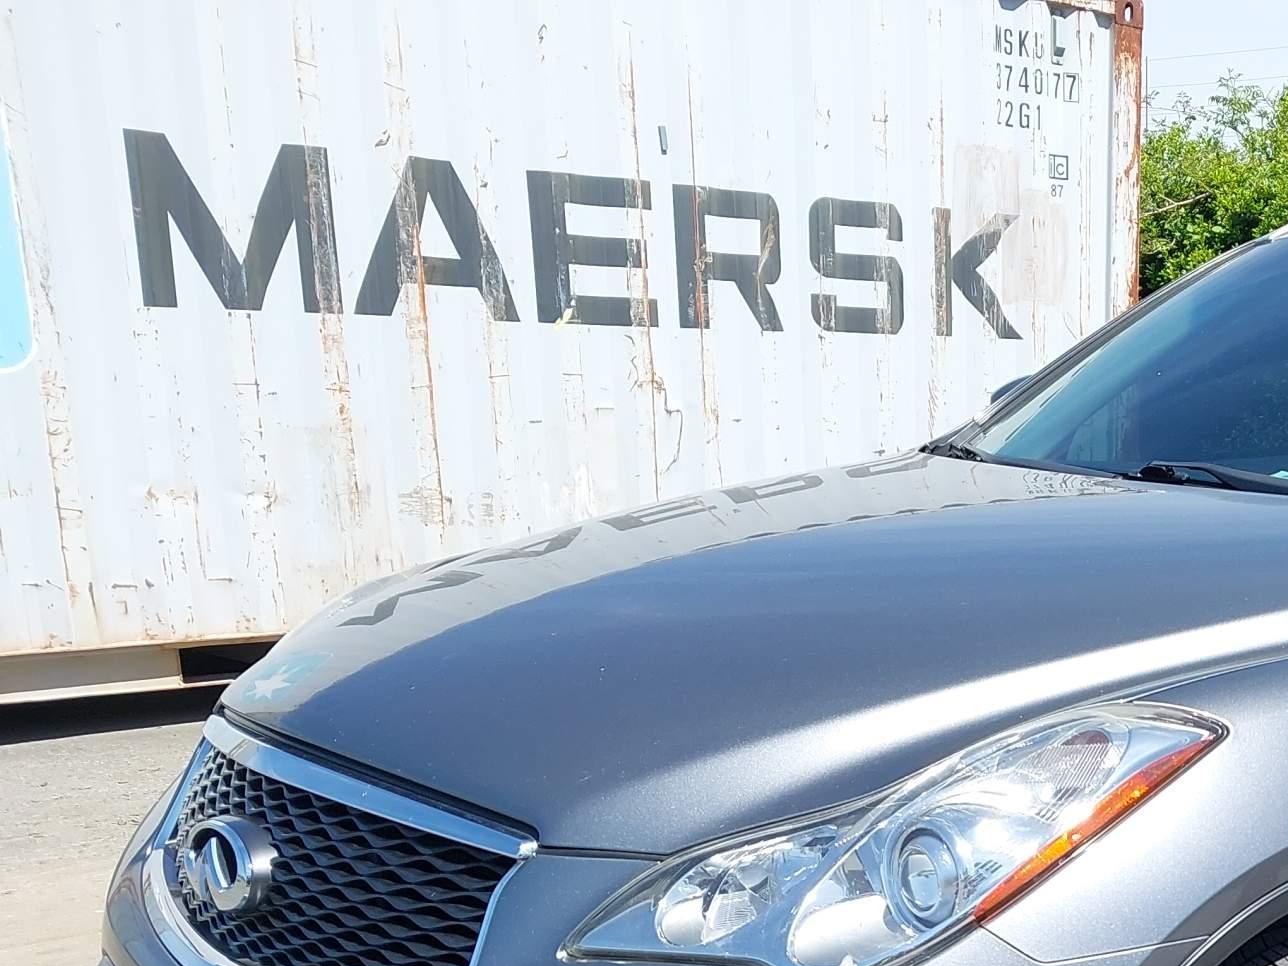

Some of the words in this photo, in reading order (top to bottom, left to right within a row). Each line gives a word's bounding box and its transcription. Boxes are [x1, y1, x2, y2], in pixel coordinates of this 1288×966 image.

[994, 24, 1044, 59] MSKU
[996, 98, 1041, 130] 22G1
[1050, 184, 1064, 198] 87
[122, 127, 1023, 340] MAERSK
